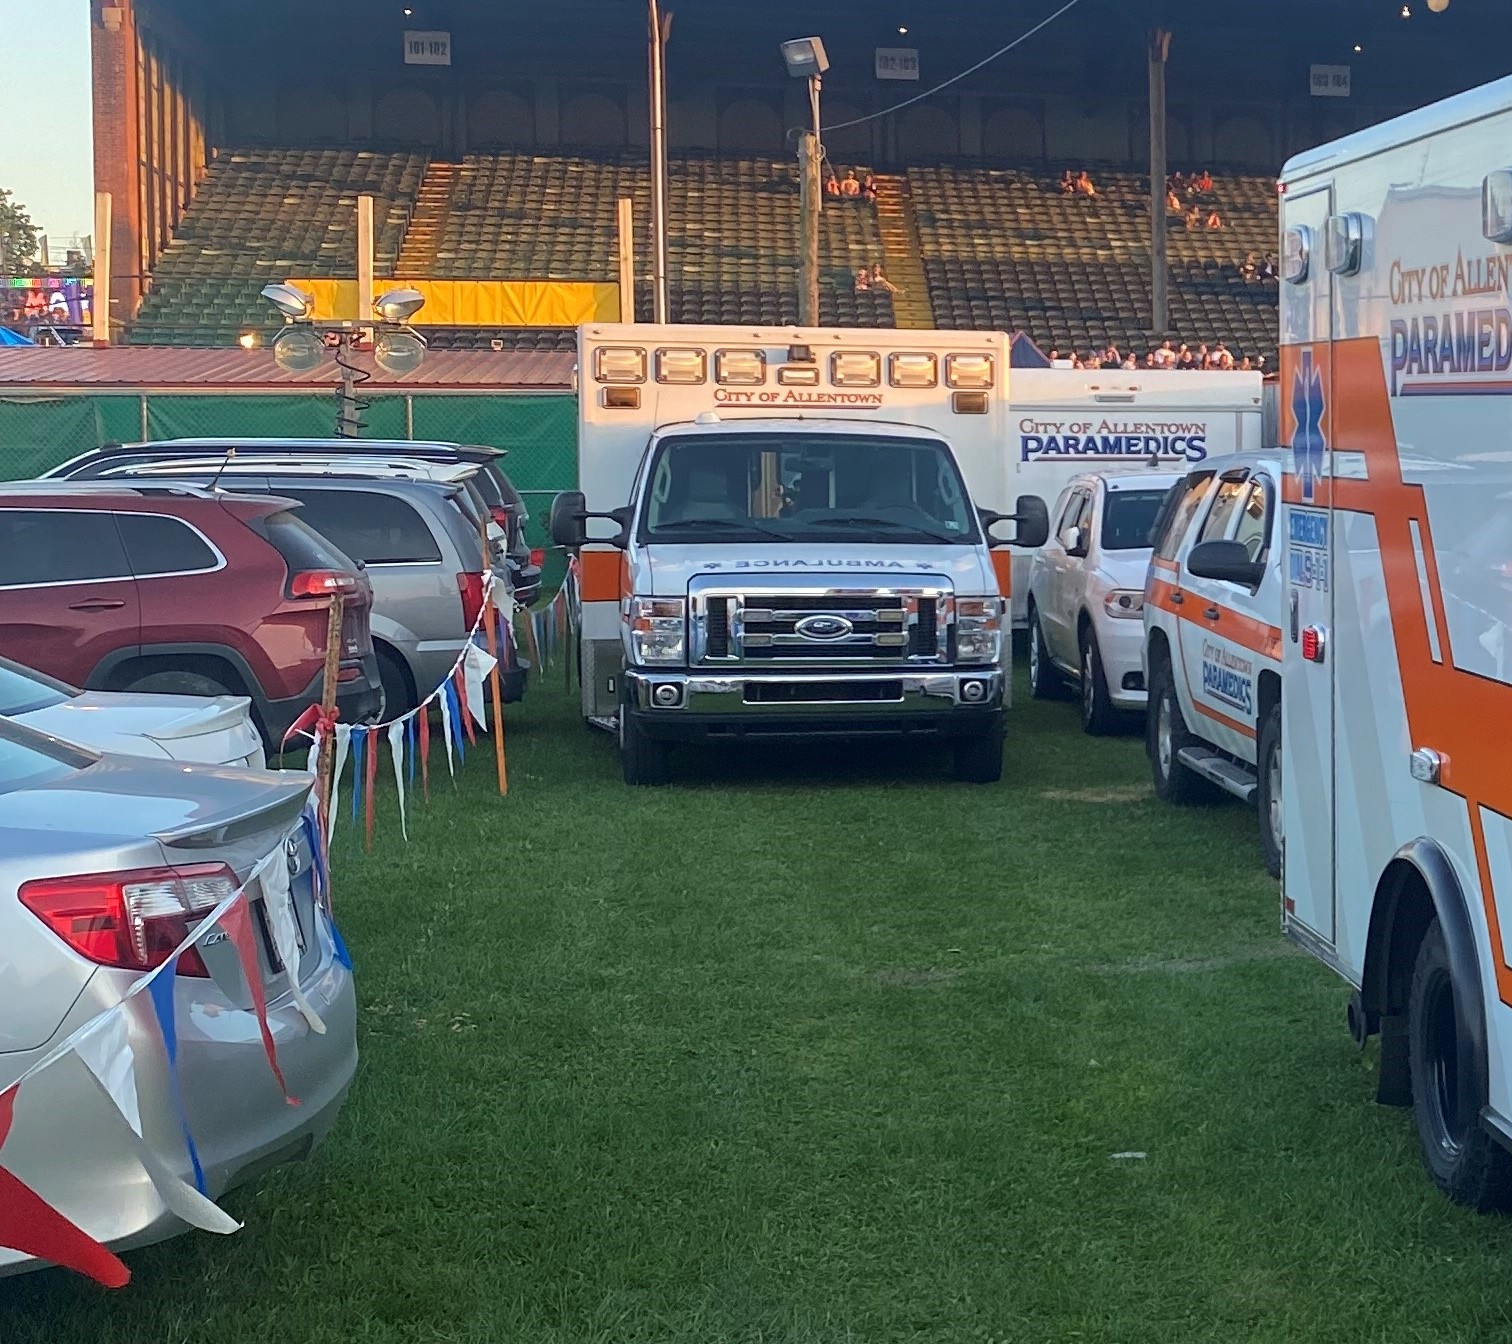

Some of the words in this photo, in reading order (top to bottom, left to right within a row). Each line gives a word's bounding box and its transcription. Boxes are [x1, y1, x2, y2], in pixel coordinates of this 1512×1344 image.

[1389, 260, 1426, 304] CITY
[1429, 263, 1449, 300] OF
[714, 388, 755, 402] CITY
[759, 392, 780, 403] OF
[783, 390, 883, 404] ALLENTOWN
[1019, 418, 1065, 434] CITY
[1069, 422, 1093, 434] OF
[1096, 419, 1206, 435] ALLENTOWN
[1020, 435, 1207, 463] PARAMEDICS
